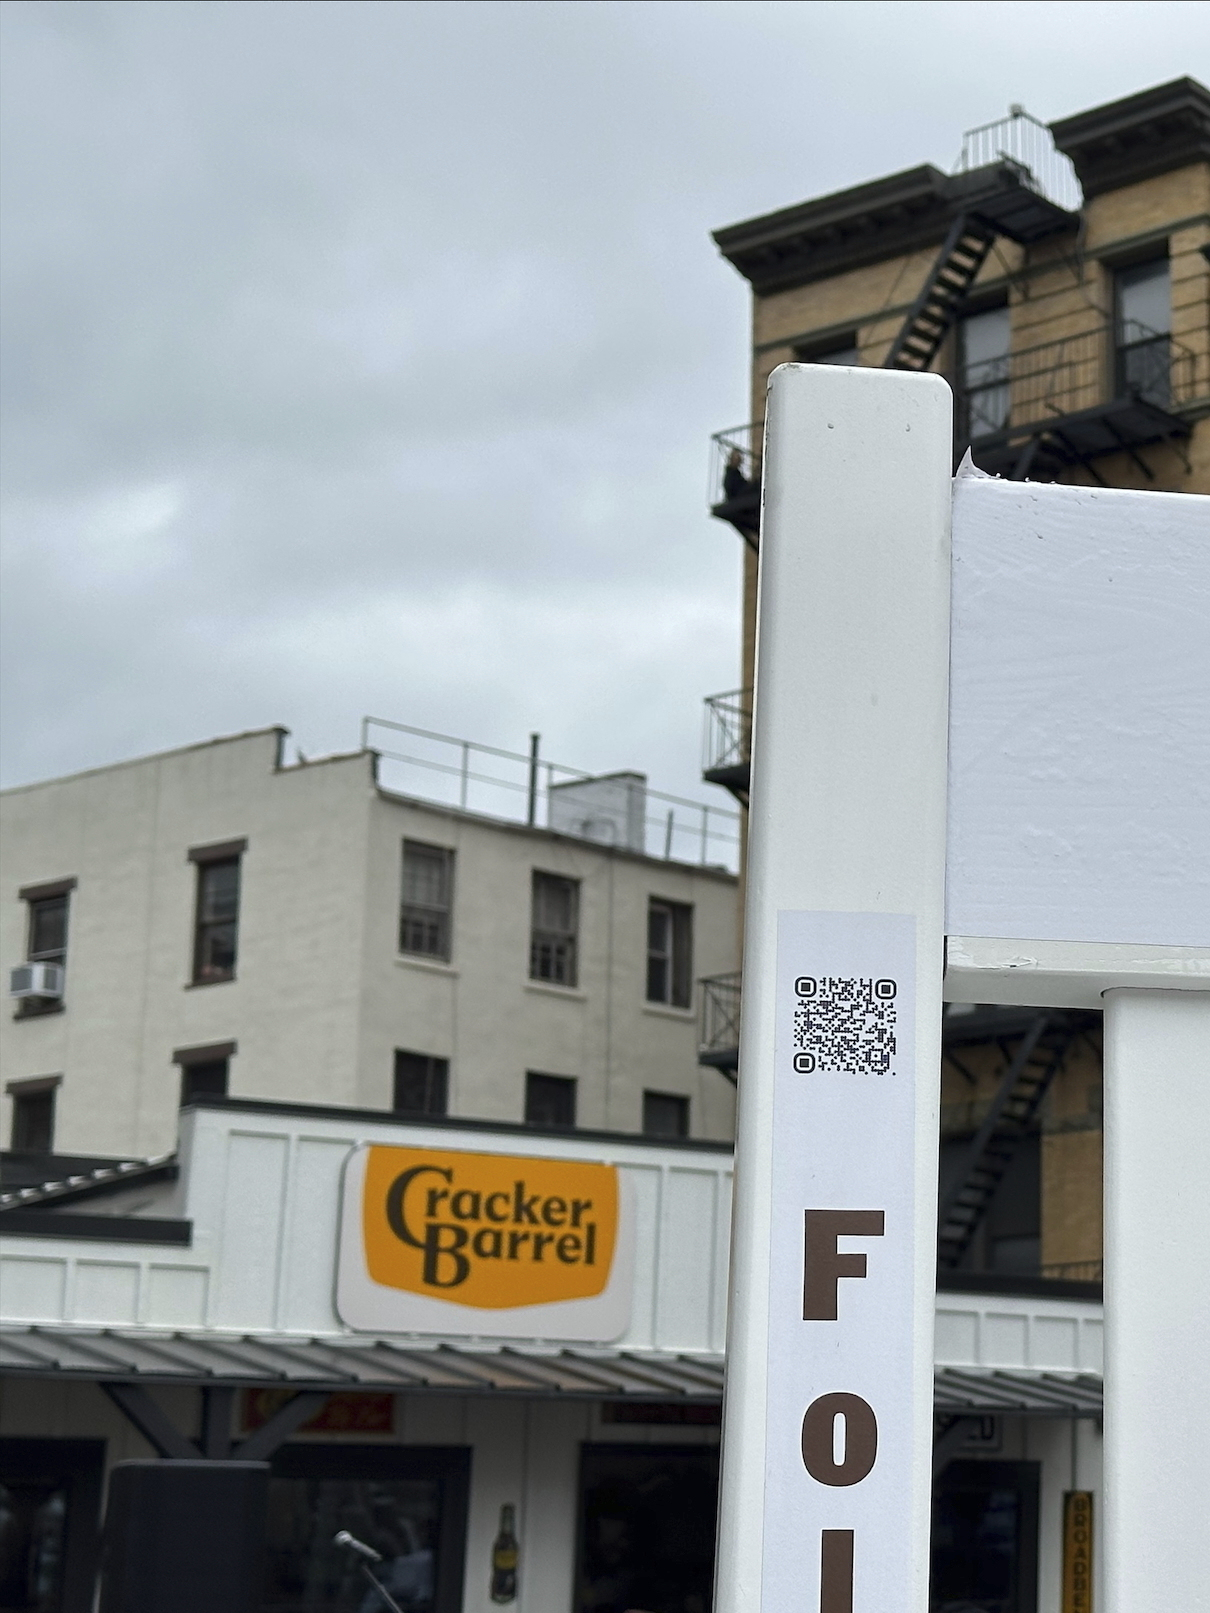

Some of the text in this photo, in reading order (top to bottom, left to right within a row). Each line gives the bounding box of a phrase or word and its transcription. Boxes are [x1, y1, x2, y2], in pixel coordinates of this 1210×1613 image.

[386, 1164, 592, 1250] Cracker
[422, 1222, 596, 1288] Barrel
[1073, 1498, 1087, 1613] BROADBE
